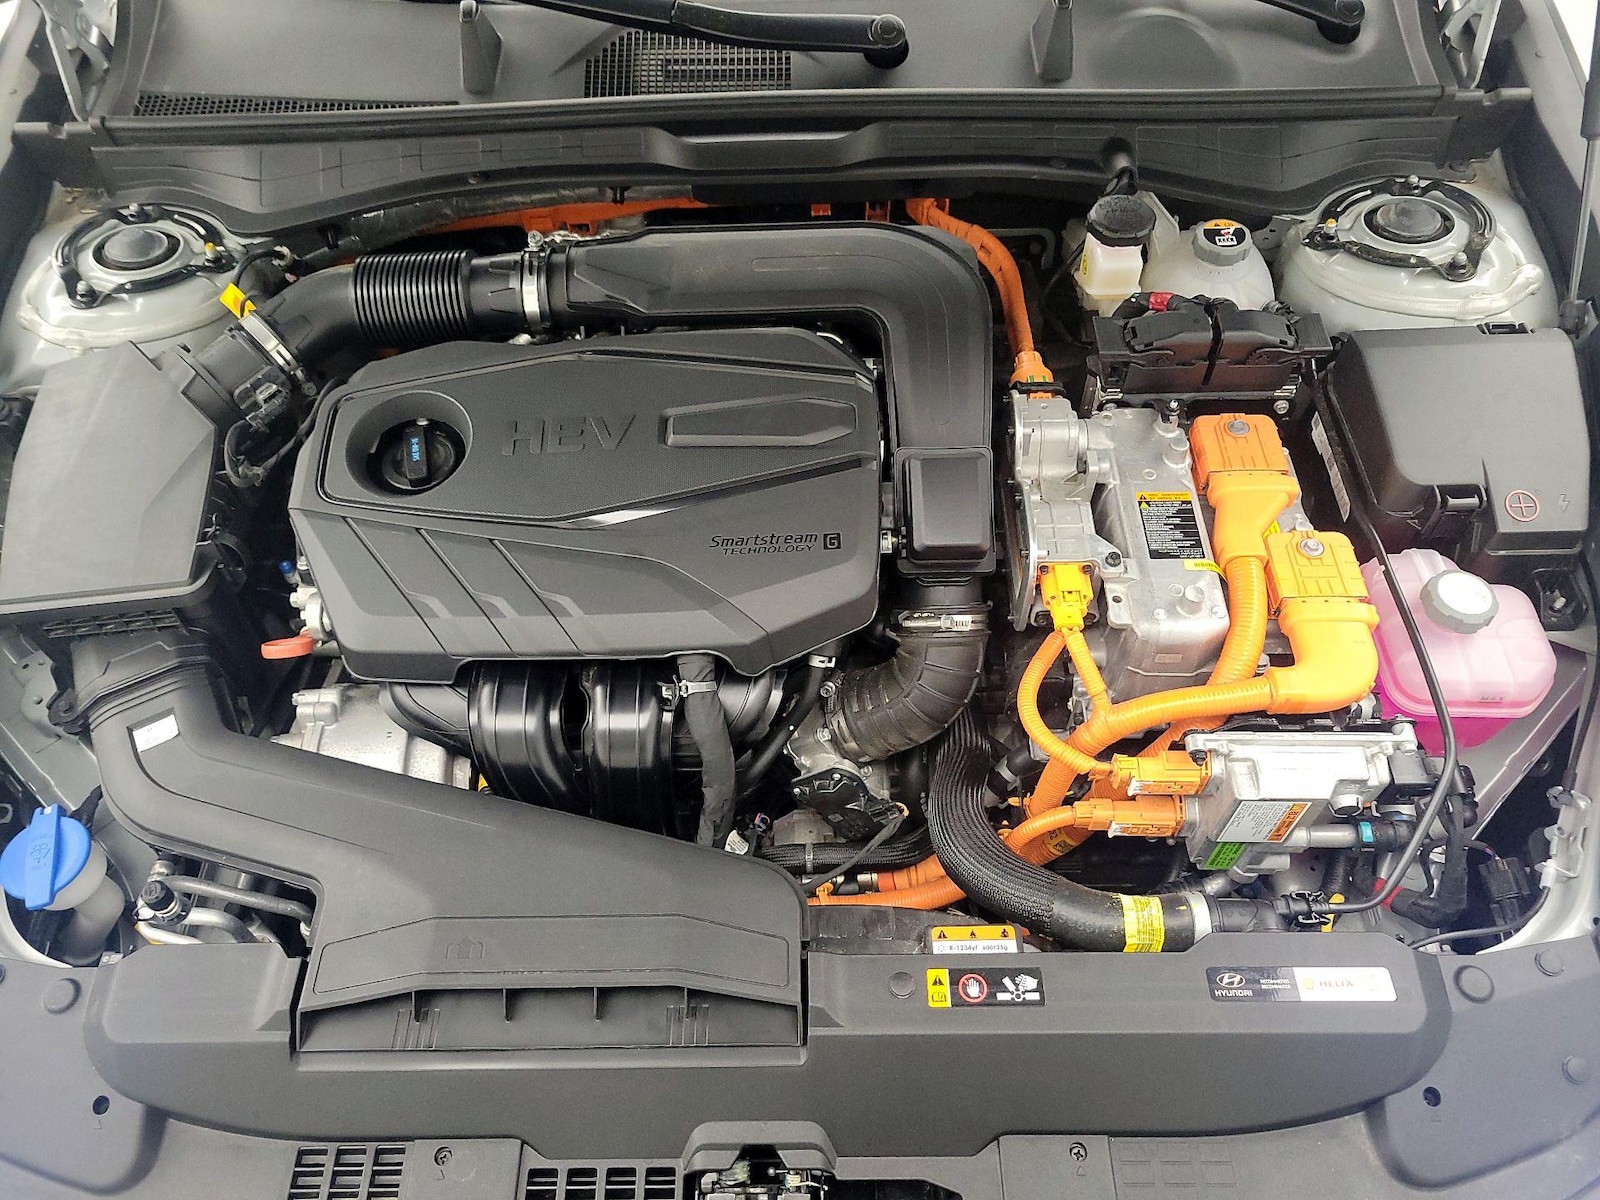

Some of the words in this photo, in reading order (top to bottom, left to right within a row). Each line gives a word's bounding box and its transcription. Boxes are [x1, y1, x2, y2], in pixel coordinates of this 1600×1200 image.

[501, 414, 637, 456] HEV
[708, 532, 818, 548] Smartstream
[825, 533, 840, 549] G
[722, 544, 816, 555] TECHNOLOGY
[1215, 989, 1253, 997] HYUNDAI
